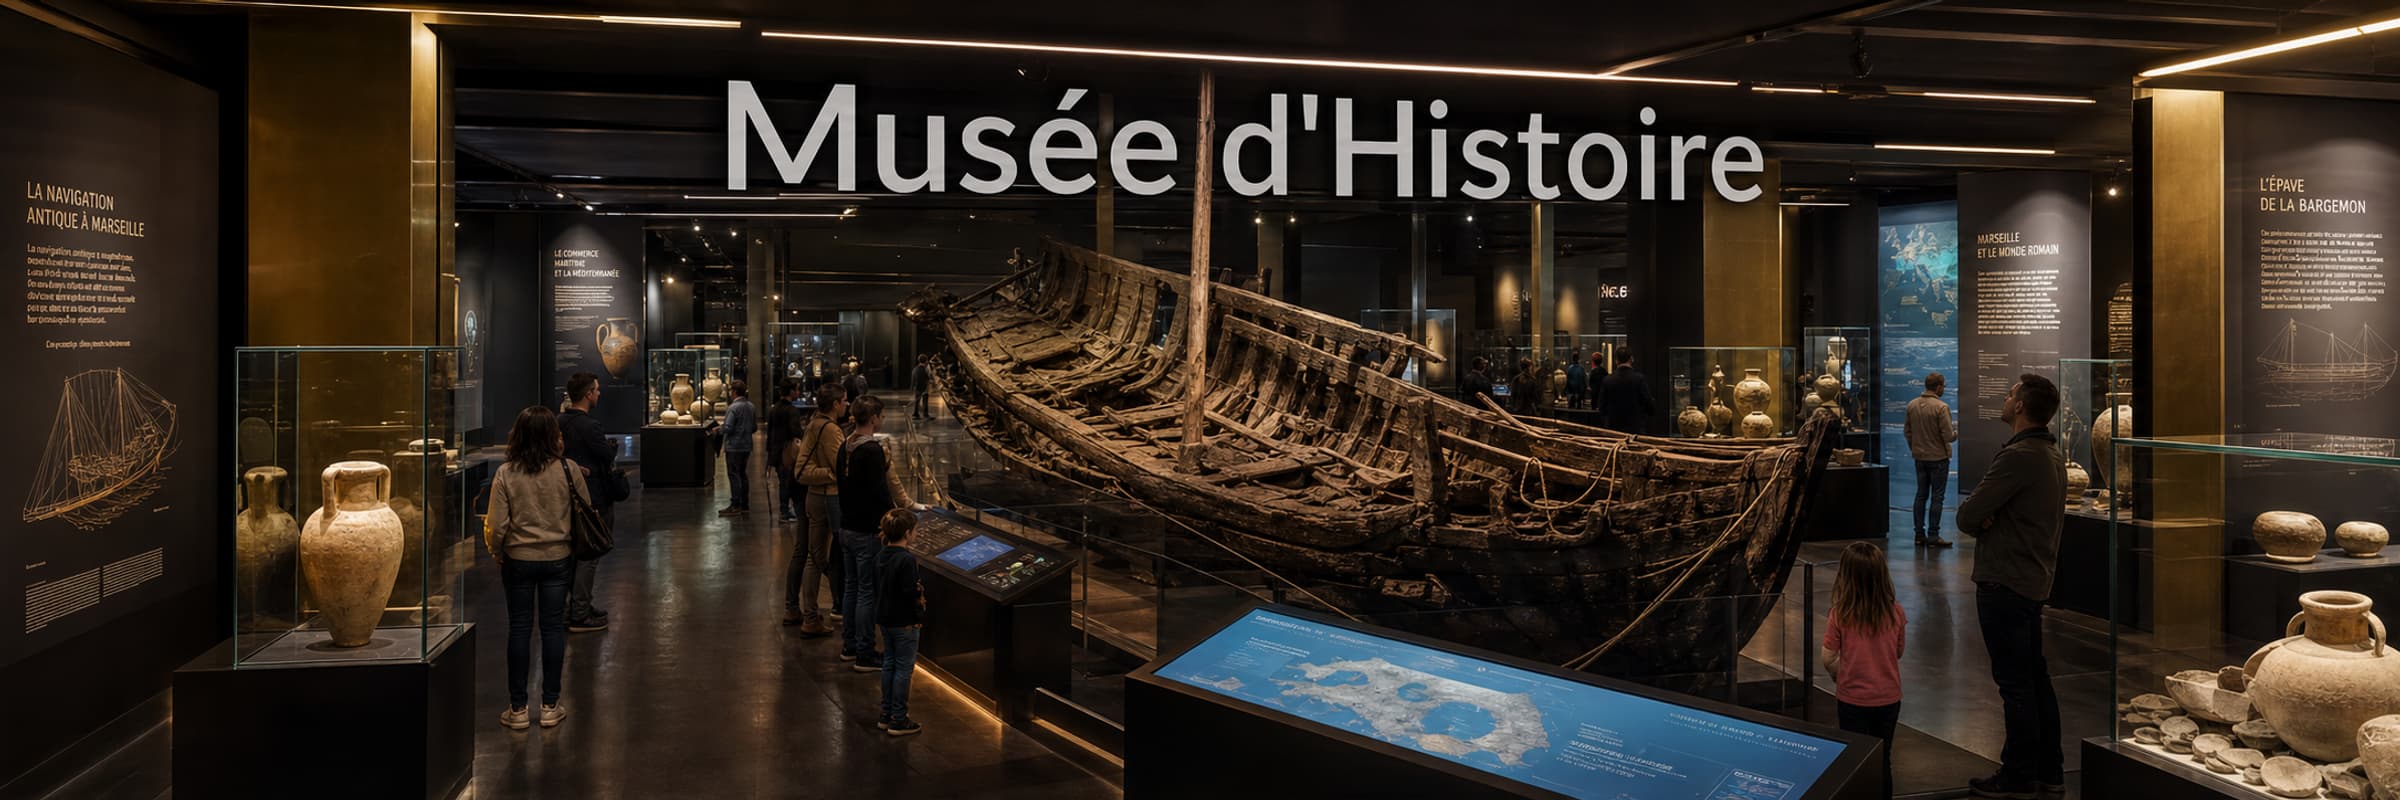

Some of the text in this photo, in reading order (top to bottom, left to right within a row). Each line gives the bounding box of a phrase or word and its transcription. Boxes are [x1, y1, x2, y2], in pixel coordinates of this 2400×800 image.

[728, 80, 1764, 202] Musée d'Histoire
[2260, 175, 2305, 193] L'ÉPAVE
[27, 181, 114, 211] LA NAVIGATION
[2260, 197, 2366, 213] DE LA BARGEMON
[26, 206, 79, 230] ANTIQUE
[91, 215, 145, 238] MARSEILLE
[1977, 232, 2020, 244] MARSEILLE
[1977, 243, 2060, 258] ET LE MONDE ROMAIN
